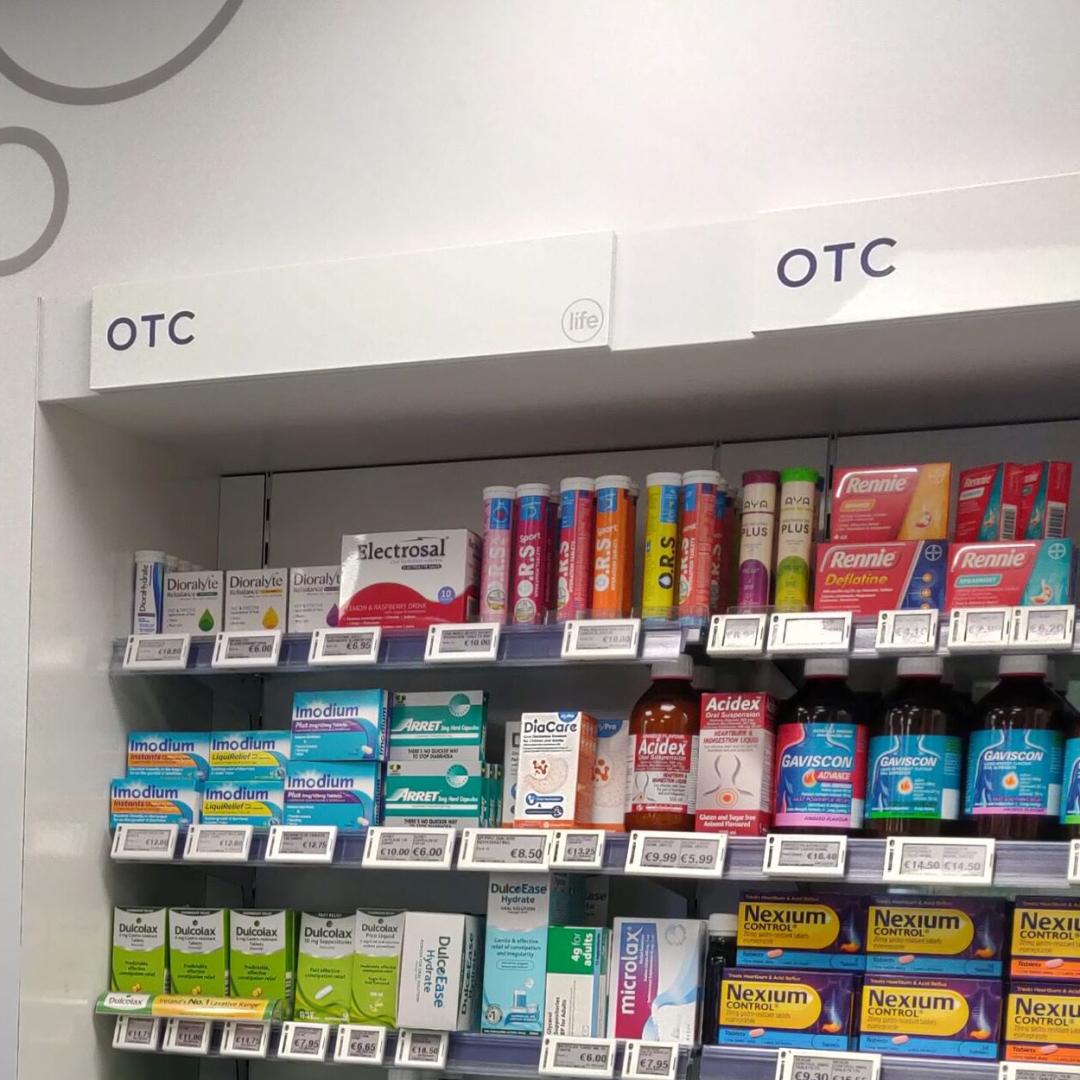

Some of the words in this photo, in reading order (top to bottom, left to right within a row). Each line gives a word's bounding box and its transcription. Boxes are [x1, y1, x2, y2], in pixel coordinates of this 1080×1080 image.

[776, 237, 898, 288] OTC
[568, 310, 601, 332] life
[107, 311, 195, 351] OTC
[846, 475, 907, 493] Rennie
[741, 525, 768, 537] PLUS
[781, 523, 810, 536] PLUS
[358, 539, 447, 561] Electrosal
[830, 548, 896, 568] Rennie
[962, 548, 1025, 568] Rennie
[167, 576, 218, 592] Dioralyte
[229, 574, 283, 590] Dioralyte
[294, 572, 341, 588] Dioralyt
[826, 573, 888, 588] Deflatine
[441, 590, 453, 598] 10
[295, 702, 359, 719] Imodium
[706, 696, 761, 712] Acidex
[397, 718, 442, 733] ARRET
[524, 719, 578, 734] DiaCare
[130, 736, 195, 752] Imodium
[212, 735, 276, 750] Imodium
[639, 738, 687, 757] Acidex
[781, 754, 853, 770] GAVISCON
[880, 755, 938, 768] GAVISCON
[983, 750, 1044, 762] GAVISCON
[287, 773, 354, 789] Imodium
[816, 770, 852, 781] ADVANCE
[113, 783, 178, 799] Imodium
[205, 785, 269, 801] Imodium
[395, 787, 440, 802] ARRET
[380, 847, 410, 857] €10.00
[412, 847, 443, 857] €6.00
[510, 847, 543, 860] €8.50
[645, 852, 678, 864] €9.99
[680, 853, 714, 865] €5.99
[943, 861, 982, 872] €14.50
[501, 896, 536, 906] Hydrate
[744, 904, 827, 925] Nexium
[874, 909, 961, 930] Nexium
[1020, 911, 1080, 932] Nexiu
[120, 922, 158, 934] Dulcolax
[174, 926, 216, 937] Dulcolax
[236, 926, 278, 937] Dulcolax
[304, 926, 353, 939] Dulcolax
[361, 922, 399, 933] Dulcolax
[744, 922, 793, 932] CONTROL
[874, 927, 925, 937] CONTROL
[573, 932, 582, 946] for
[1020, 930, 1074, 940] CONTROL
[570, 947, 583, 963] 4g
[583, 932, 594, 967] adults
[423, 949, 436, 994] Hydrate
[621, 925, 643, 1016] microlax
[727, 984, 808, 1005] Nexium
[868, 989, 955, 1011] Nexium
[726, 1001, 774, 1011] CONTROL
[868, 1006, 919, 1018] CONTROL
[1015, 997, 1080, 1018] Nexiu
[1014, 1015, 1069, 1027] CONTROL
[294, 1039, 320, 1048] €7.95
[580, 1052, 608, 1063] €6.00
[639, 1059, 670, 1070] €7.95
